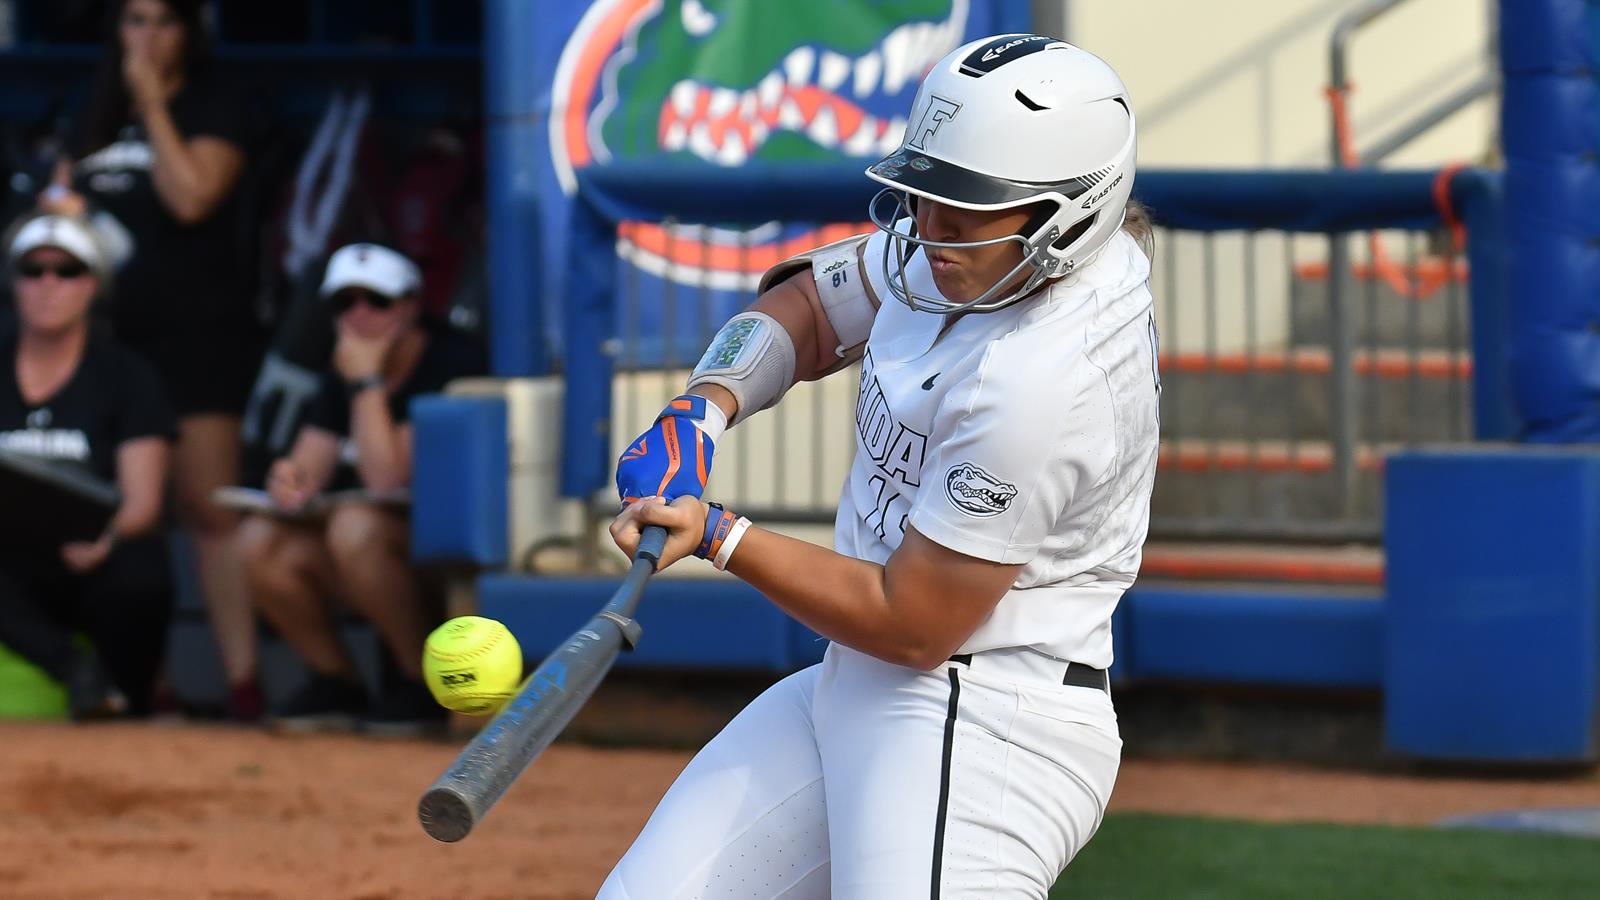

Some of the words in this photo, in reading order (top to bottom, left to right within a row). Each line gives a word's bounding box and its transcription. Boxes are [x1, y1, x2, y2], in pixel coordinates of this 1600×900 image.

[995, 36, 1050, 54] EASTON
[908, 94, 961, 151] F
[1091, 172, 1123, 204] EASTON
